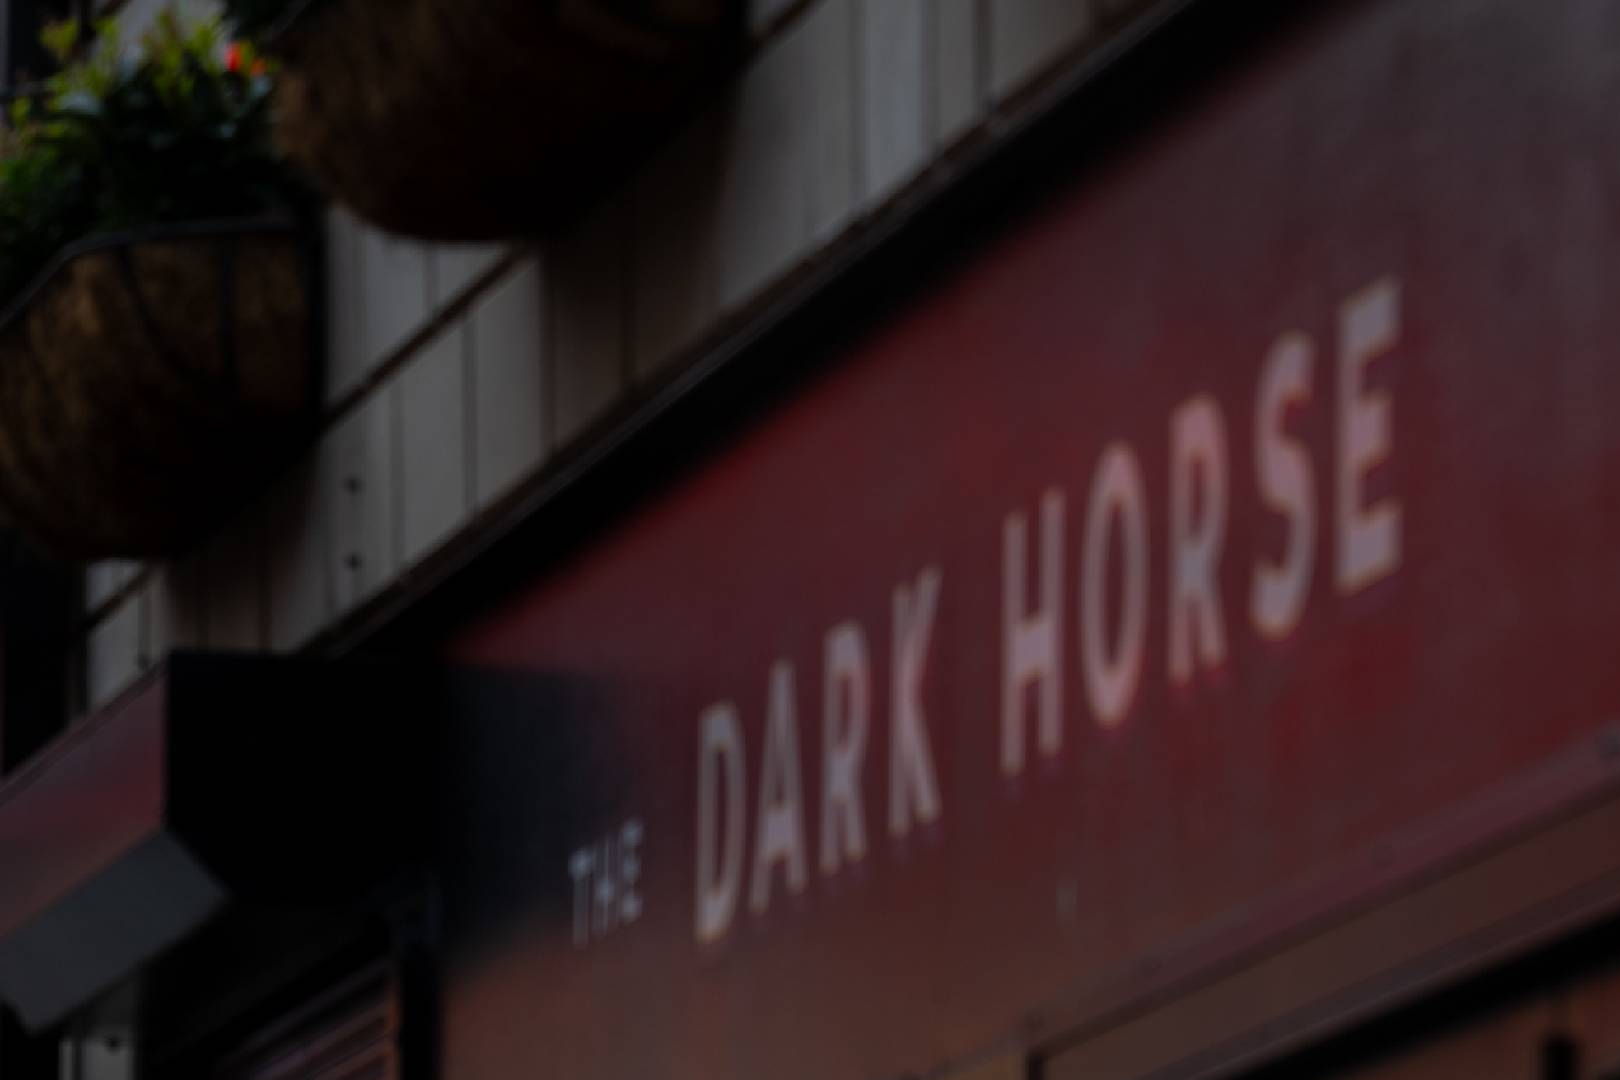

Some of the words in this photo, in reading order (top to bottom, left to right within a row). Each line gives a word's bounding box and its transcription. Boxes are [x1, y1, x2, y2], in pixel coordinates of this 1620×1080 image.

[568, 817, 644, 947] THE
[693, 566, 942, 943] DARK
[1002, 276, 1402, 776] HORSE
